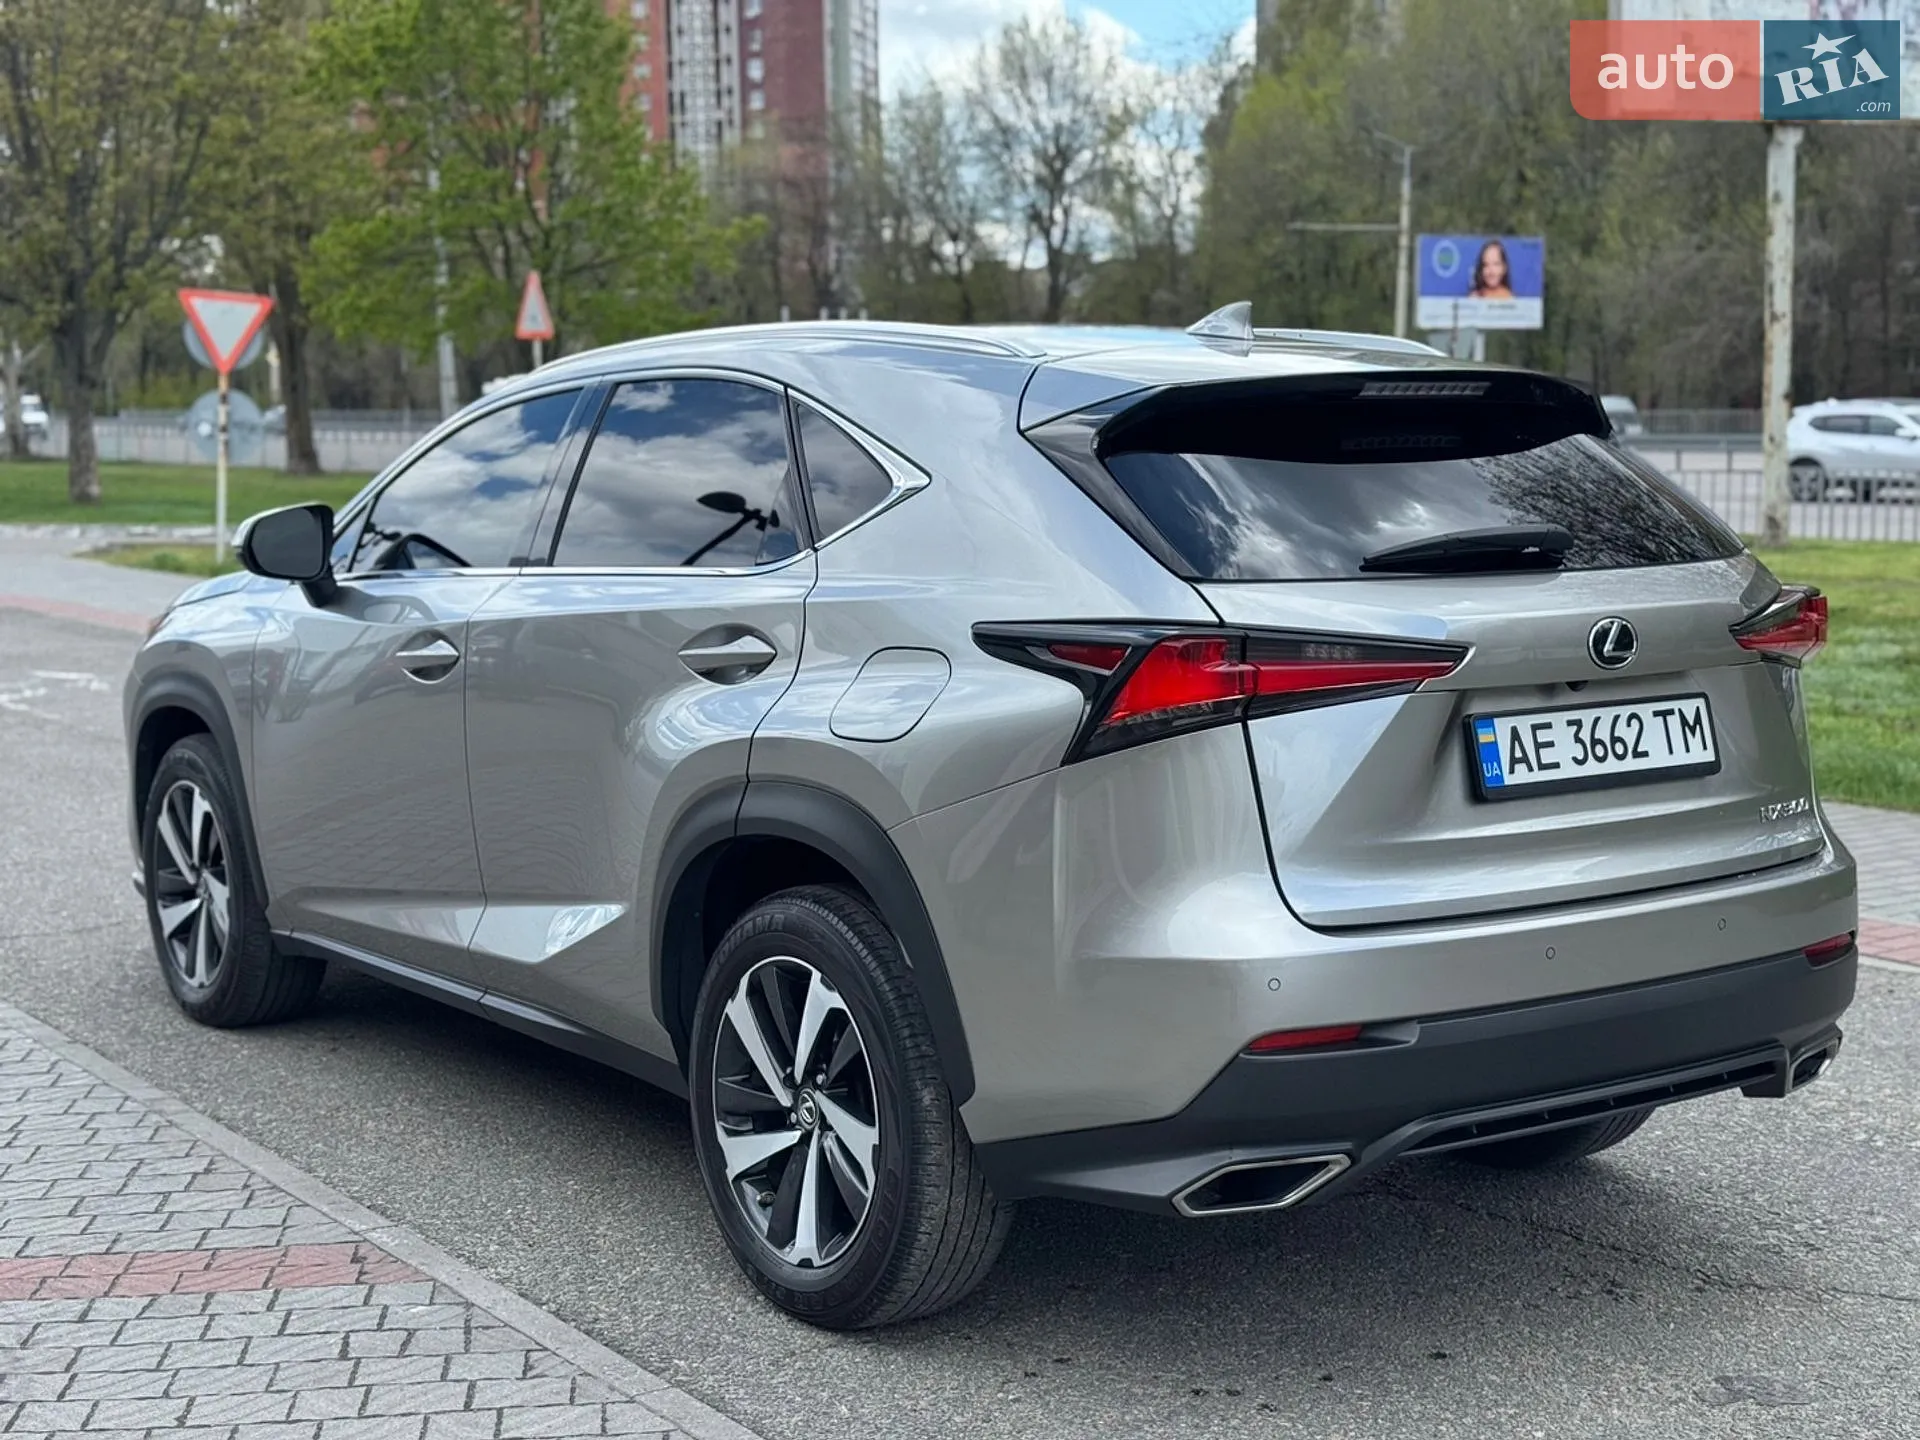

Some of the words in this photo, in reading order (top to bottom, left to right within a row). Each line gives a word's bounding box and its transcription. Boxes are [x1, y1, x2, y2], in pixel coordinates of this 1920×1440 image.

[1507, 721, 1562, 776] AE
[1566, 711, 1650, 767] 3662
[1652, 705, 1709, 756] TM
[1482, 761, 1502, 778] UA
